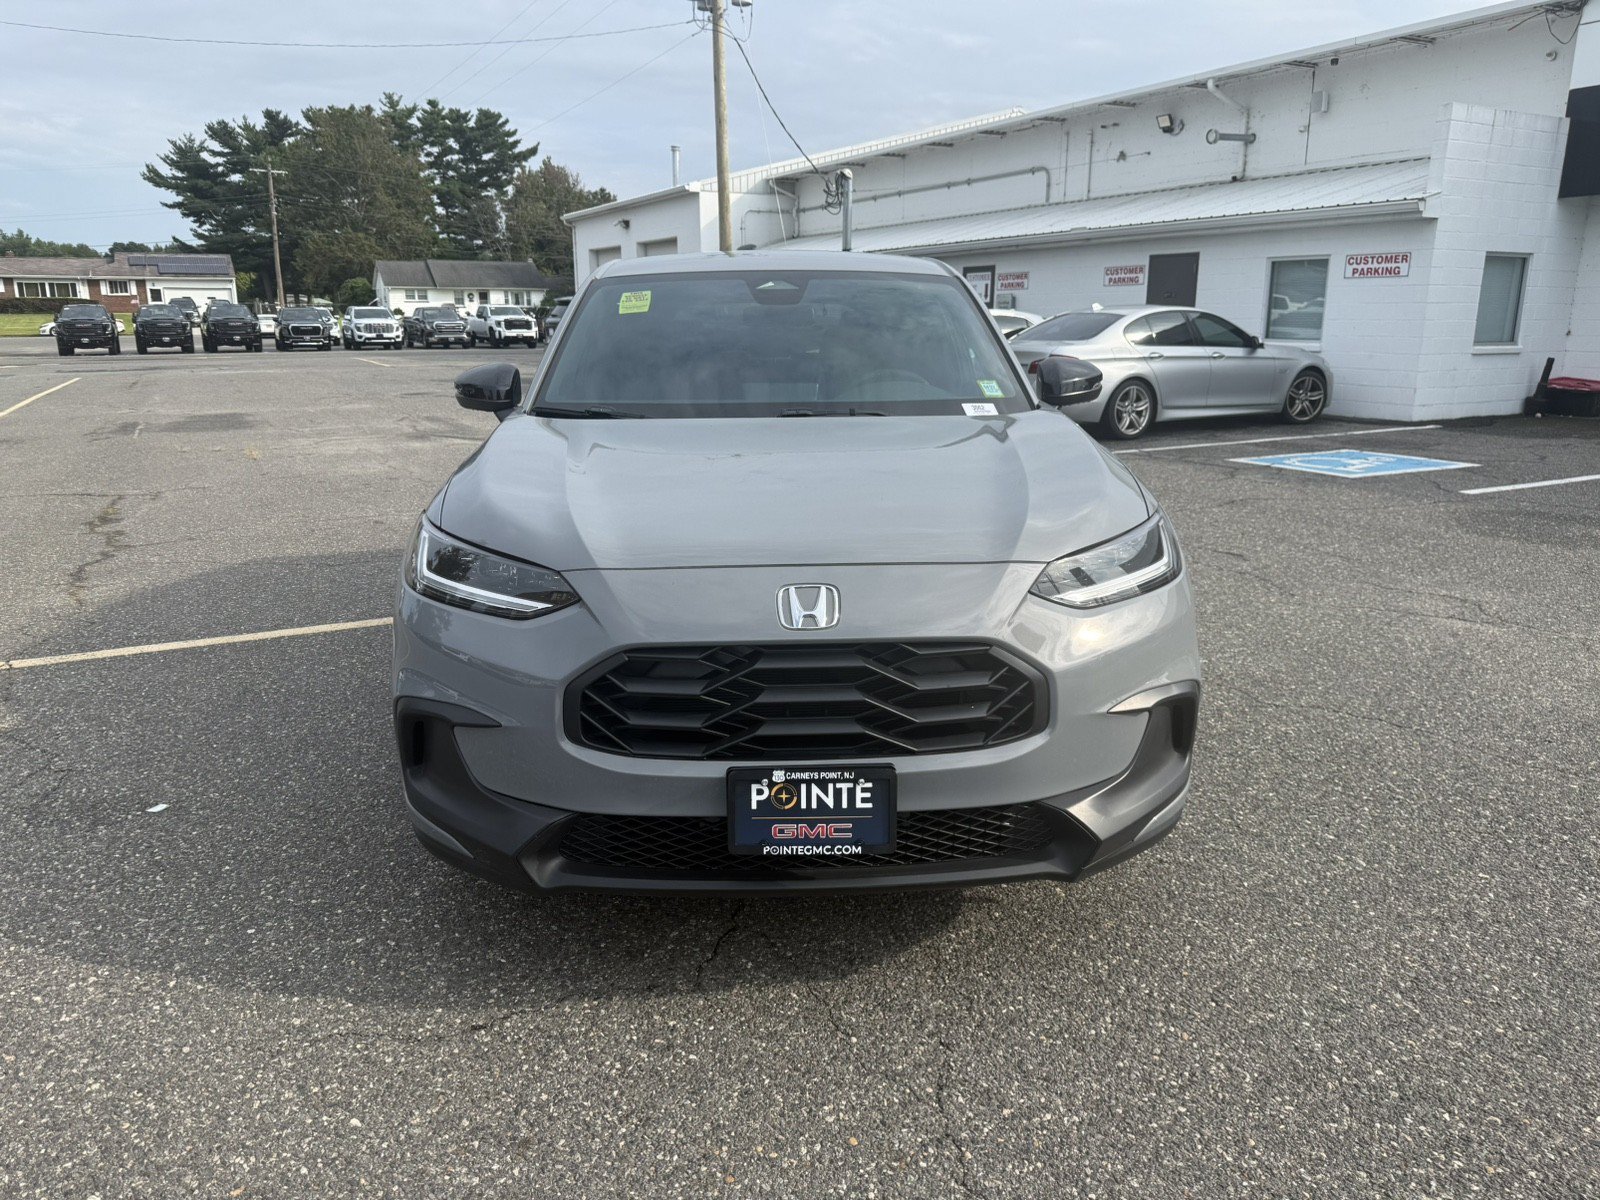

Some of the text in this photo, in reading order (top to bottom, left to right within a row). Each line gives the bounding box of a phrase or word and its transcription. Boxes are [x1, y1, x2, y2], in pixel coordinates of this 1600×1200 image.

[1348, 254, 1408, 266] CUSTOMER
[1105, 267, 1144, 276] CUSTOMER
[1352, 266, 1401, 276] PARKING
[998, 273, 1029, 281] CUSTOMER
[1108, 276, 1140, 285] PARKING
[1000, 281, 1025, 289] PARKING
[786, 772, 819, 780] CARNEYS
[750, 782, 873, 810] POINTE
[771, 823, 853, 839] GMC
[763, 845, 862, 855] POINTEGMC.COM
